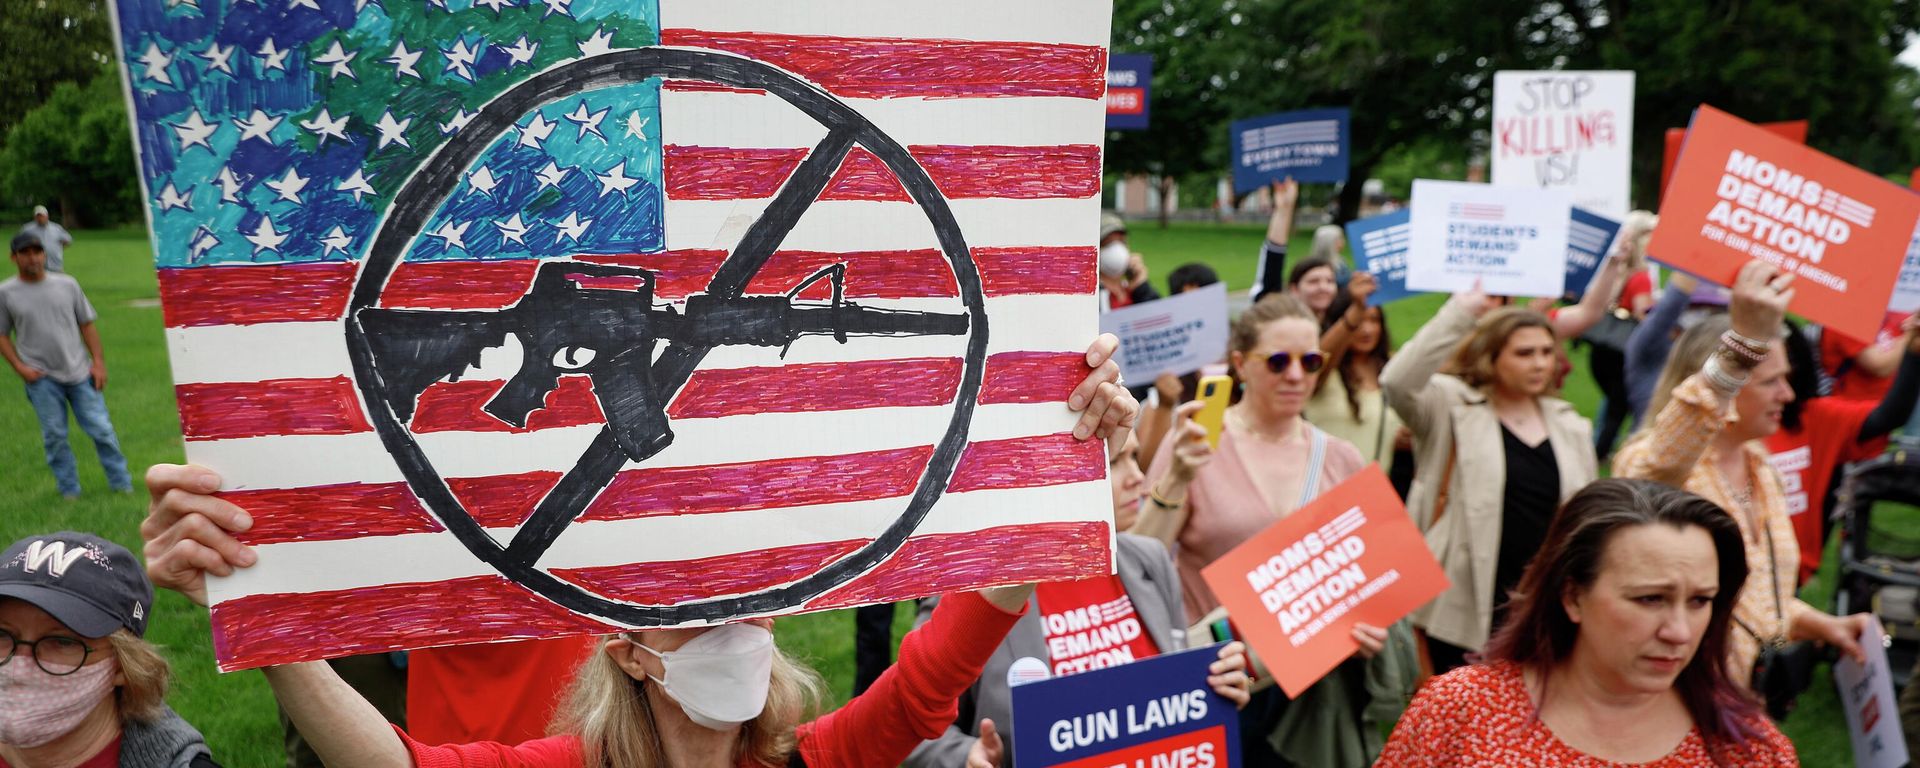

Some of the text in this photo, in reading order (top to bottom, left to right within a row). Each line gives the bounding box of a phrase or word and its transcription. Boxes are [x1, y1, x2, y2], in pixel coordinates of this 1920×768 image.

[1107, 70, 1138, 87] AWS
[1516, 76, 1595, 115] STOP
[1497, 110, 1617, 159] KILLING
[1534, 151, 1580, 189] US!
[1724, 148, 1824, 206] MOMS
[1705, 200, 1827, 264] ACTION
[1716, 173, 1851, 245] DEMAND
[1798, 262, 1848, 293] AMERICA
[24, 540, 88, 578] W
[1246, 531, 1325, 594] MOMS
[1260, 535, 1366, 614] DEMAND
[1277, 562, 1367, 636] ACTION
[1046, 617, 1142, 661] EMAND
[1053, 644, 1136, 677] CTION
[1049, 688, 1209, 752] GUN LAWS
